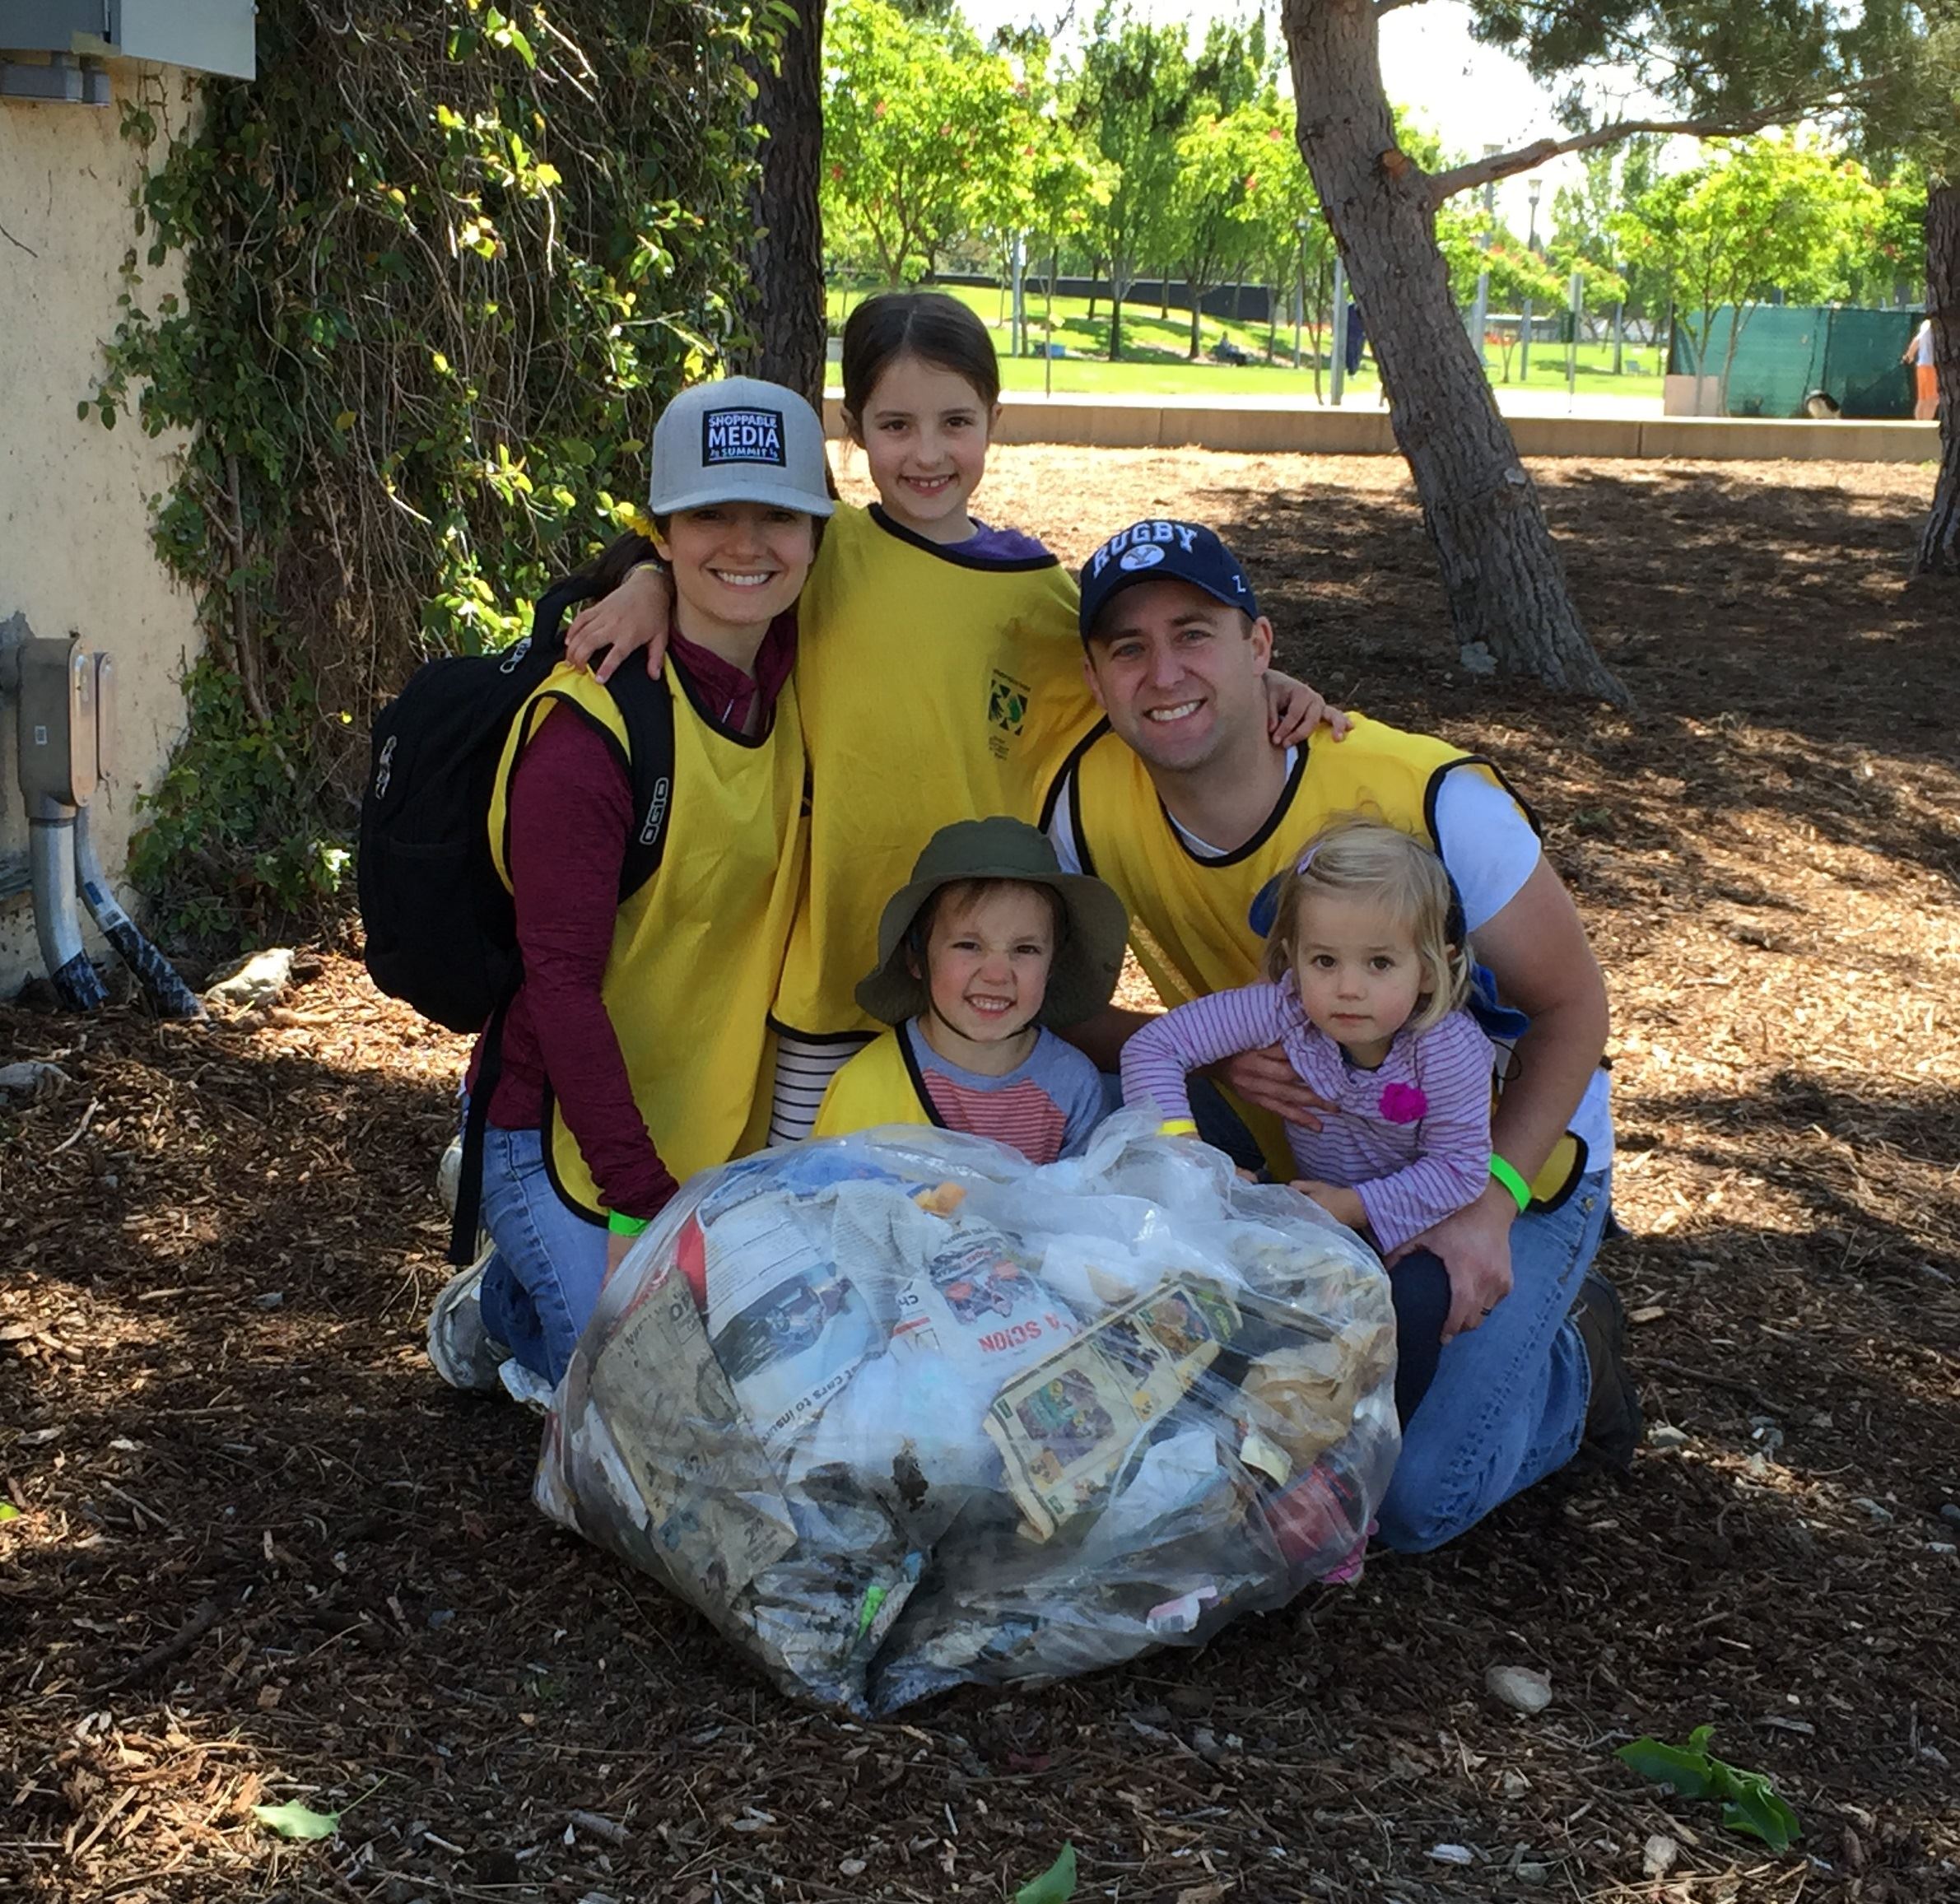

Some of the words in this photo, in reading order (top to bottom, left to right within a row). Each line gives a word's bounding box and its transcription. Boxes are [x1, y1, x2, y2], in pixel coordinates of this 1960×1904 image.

[709, 414, 778, 429] SHOPPABLE
[709, 426, 780, 449] MEDIA
[722, 447, 767, 457] SUMMIT
[1093, 521, 1198, 580] RUGBY
[977, 1320, 1042, 1352] SCION
[812, 1376, 843, 1399] cars
[796, 1397, 812, 1413] to
